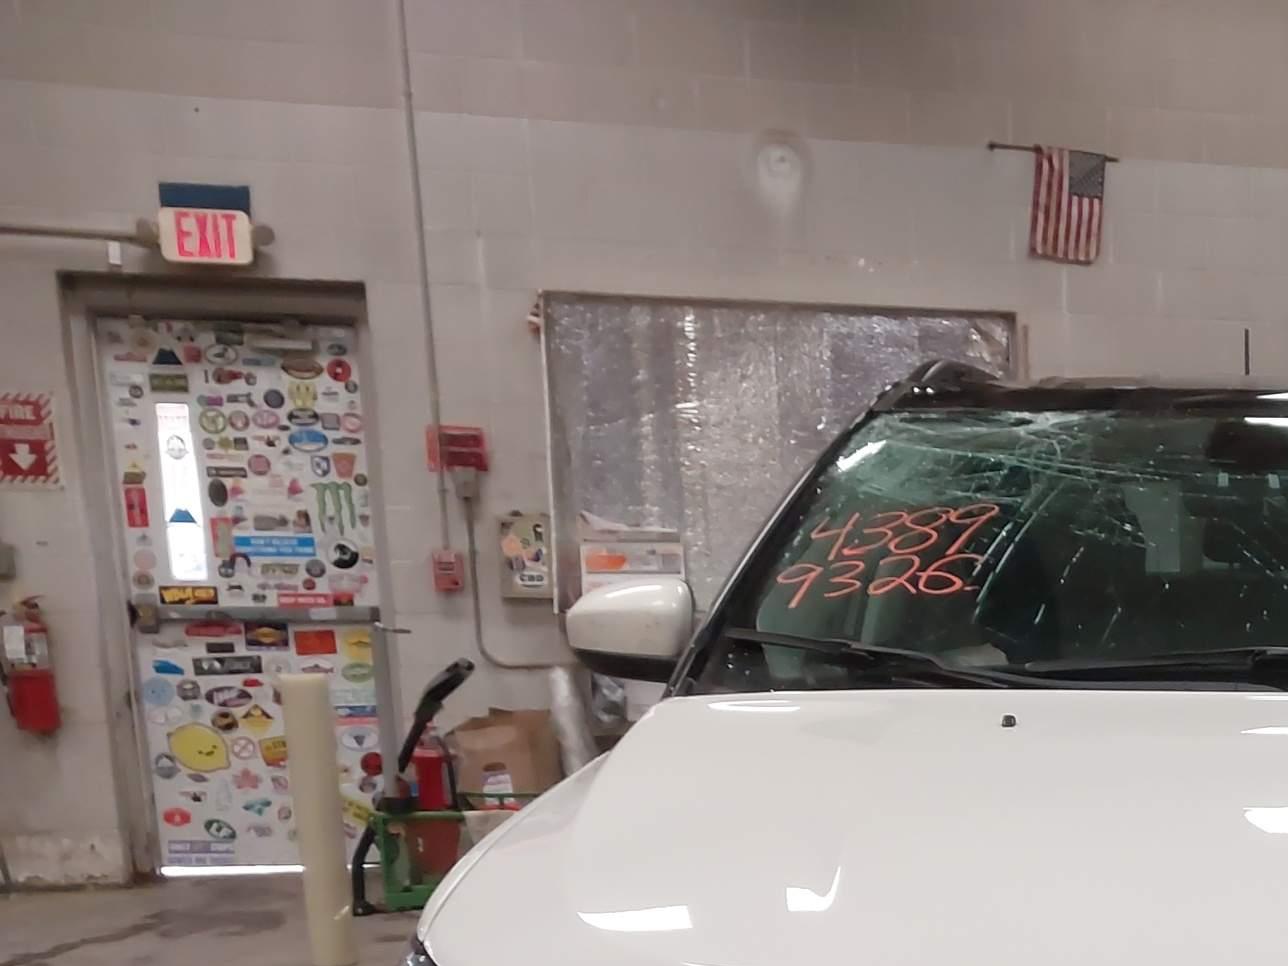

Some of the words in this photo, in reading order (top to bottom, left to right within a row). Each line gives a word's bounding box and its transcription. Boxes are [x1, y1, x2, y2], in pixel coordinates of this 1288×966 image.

[174, 210, 237, 259] EXIT
[809, 502, 1001, 561] 4389
[776, 553, 983, 609] 9326
